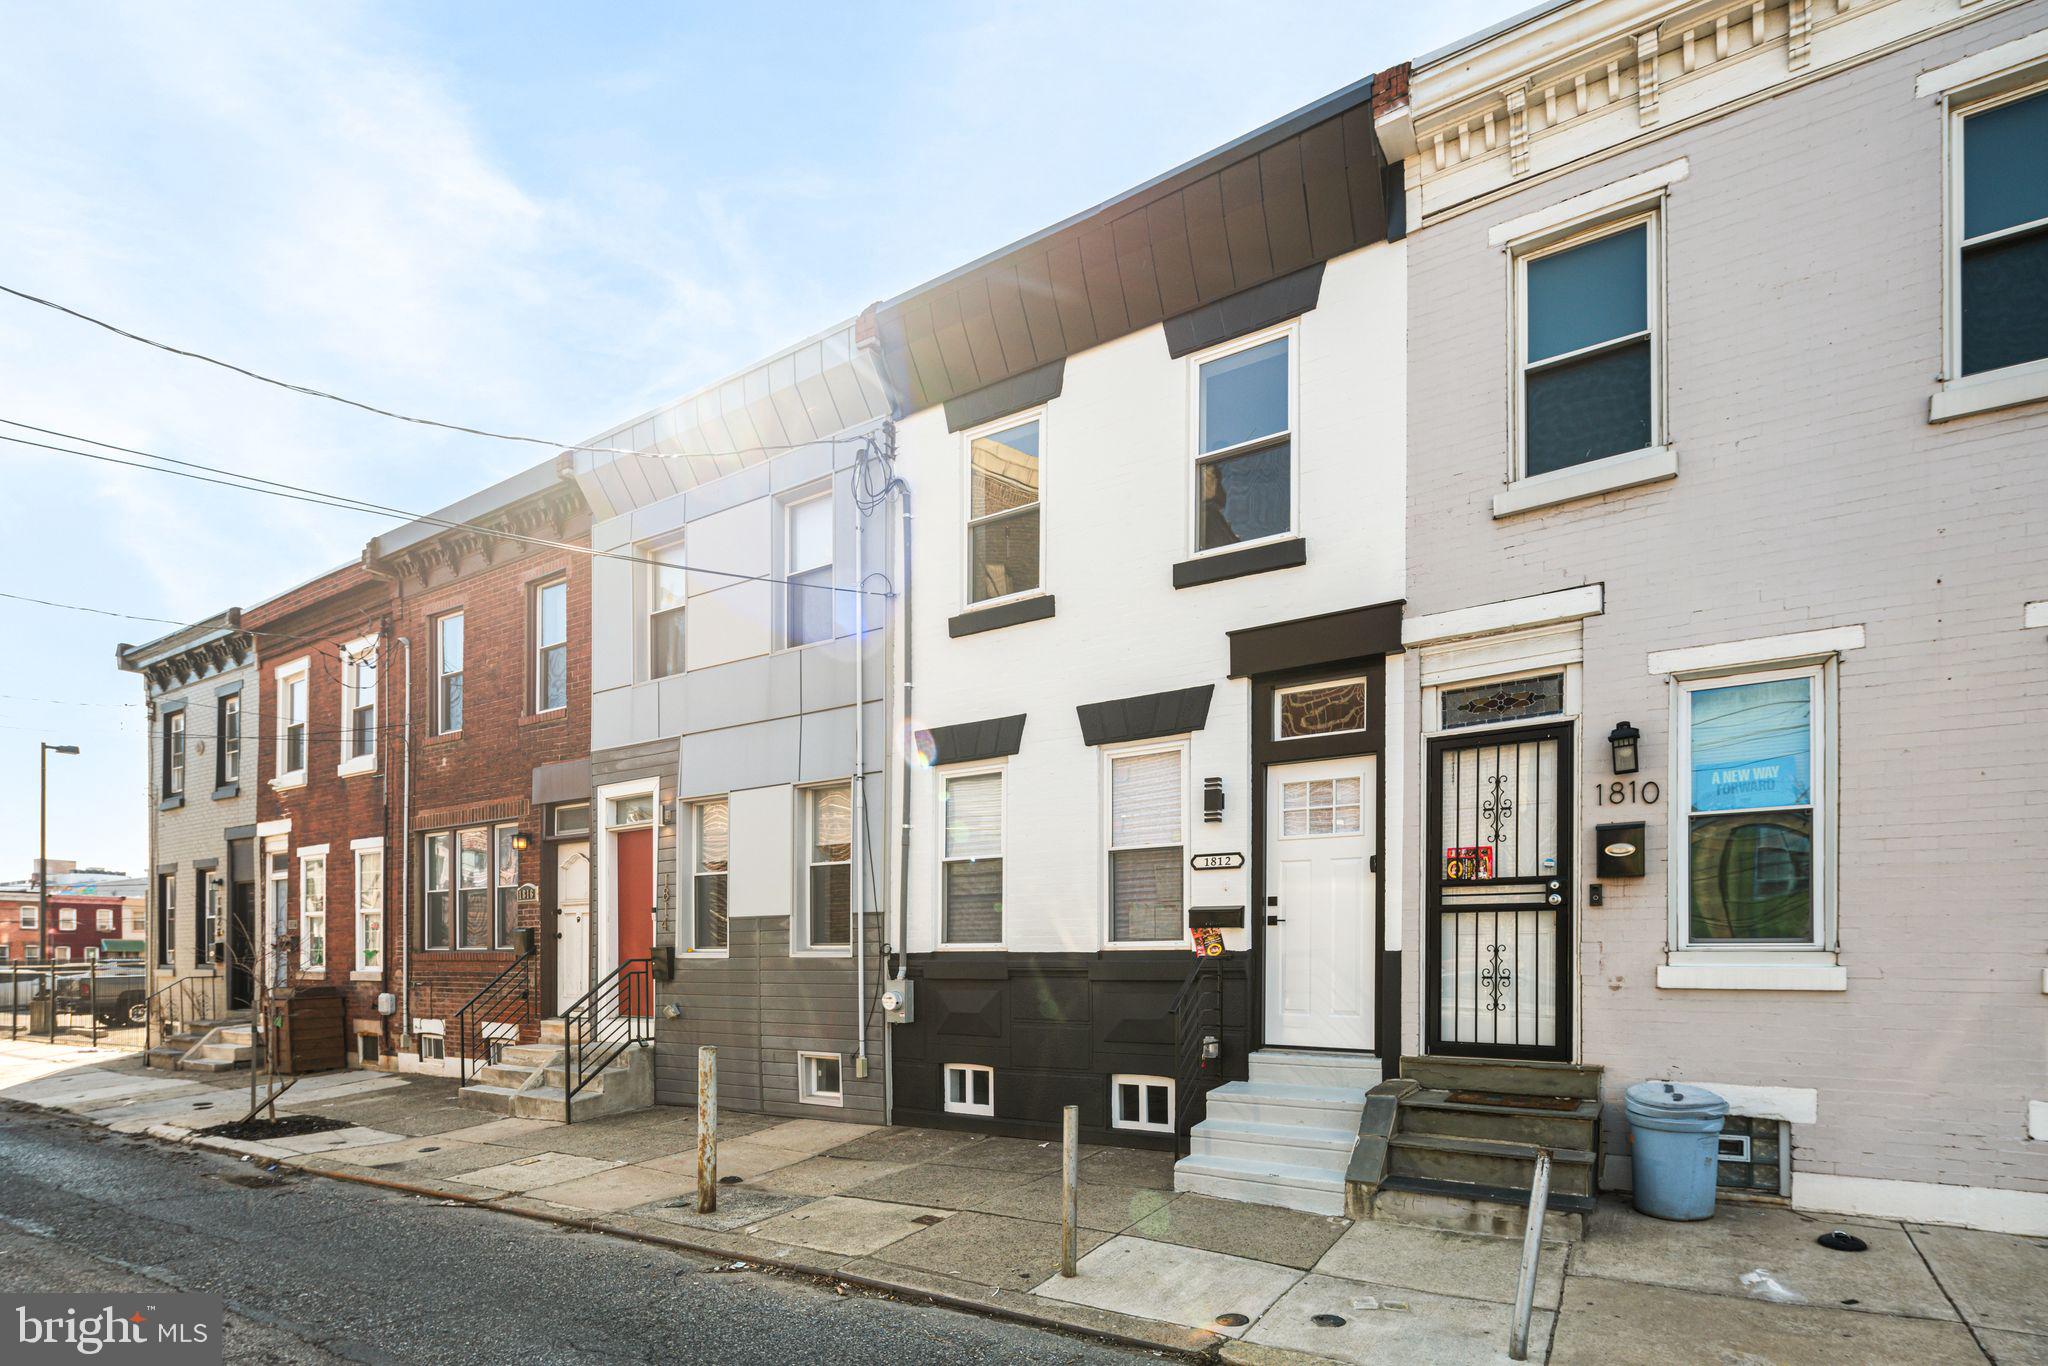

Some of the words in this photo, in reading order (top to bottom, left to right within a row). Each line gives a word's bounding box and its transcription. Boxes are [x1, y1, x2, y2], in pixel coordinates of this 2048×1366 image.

[1712, 769, 1720, 784] A
[1723, 768, 1750, 784] NEW
[1752, 765, 1780, 780] WAY
[1596, 781, 1660, 806] 1810
[1716, 779, 1776, 796] FORWARD
[1204, 856, 1232, 866] 1812
[661, 873, 670, 930] 1814
